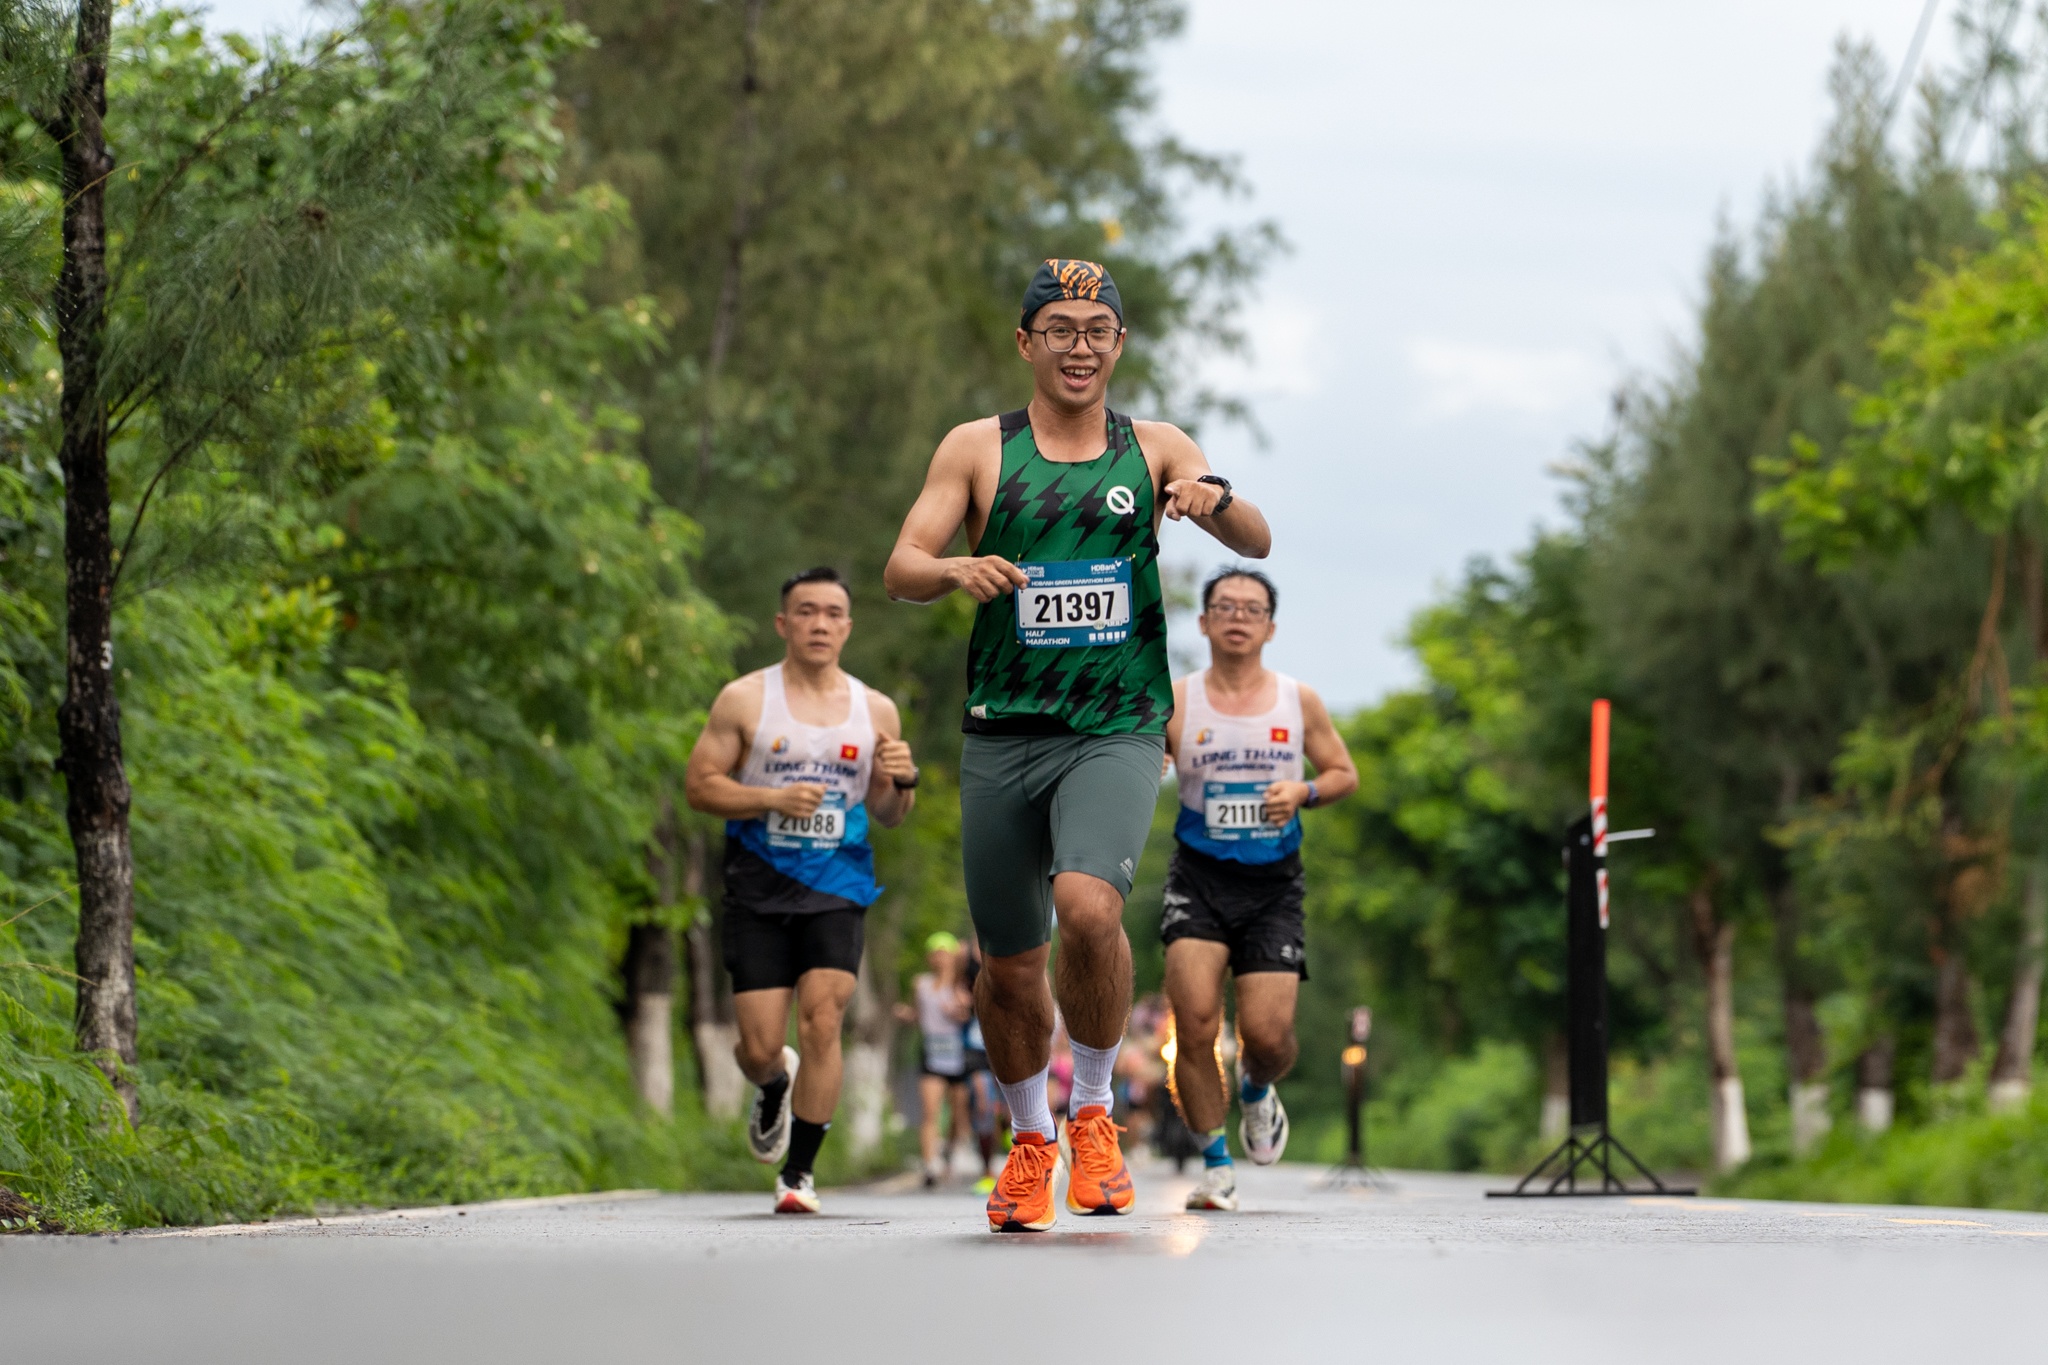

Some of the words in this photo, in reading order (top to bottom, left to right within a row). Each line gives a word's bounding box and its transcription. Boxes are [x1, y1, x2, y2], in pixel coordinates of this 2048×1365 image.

[1091, 563, 1116, 572] HDBank
[1034, 590, 1115, 623] 21397
[1025, 630, 1046, 638] HALF
[1025, 637, 1070, 645] MARATHON
